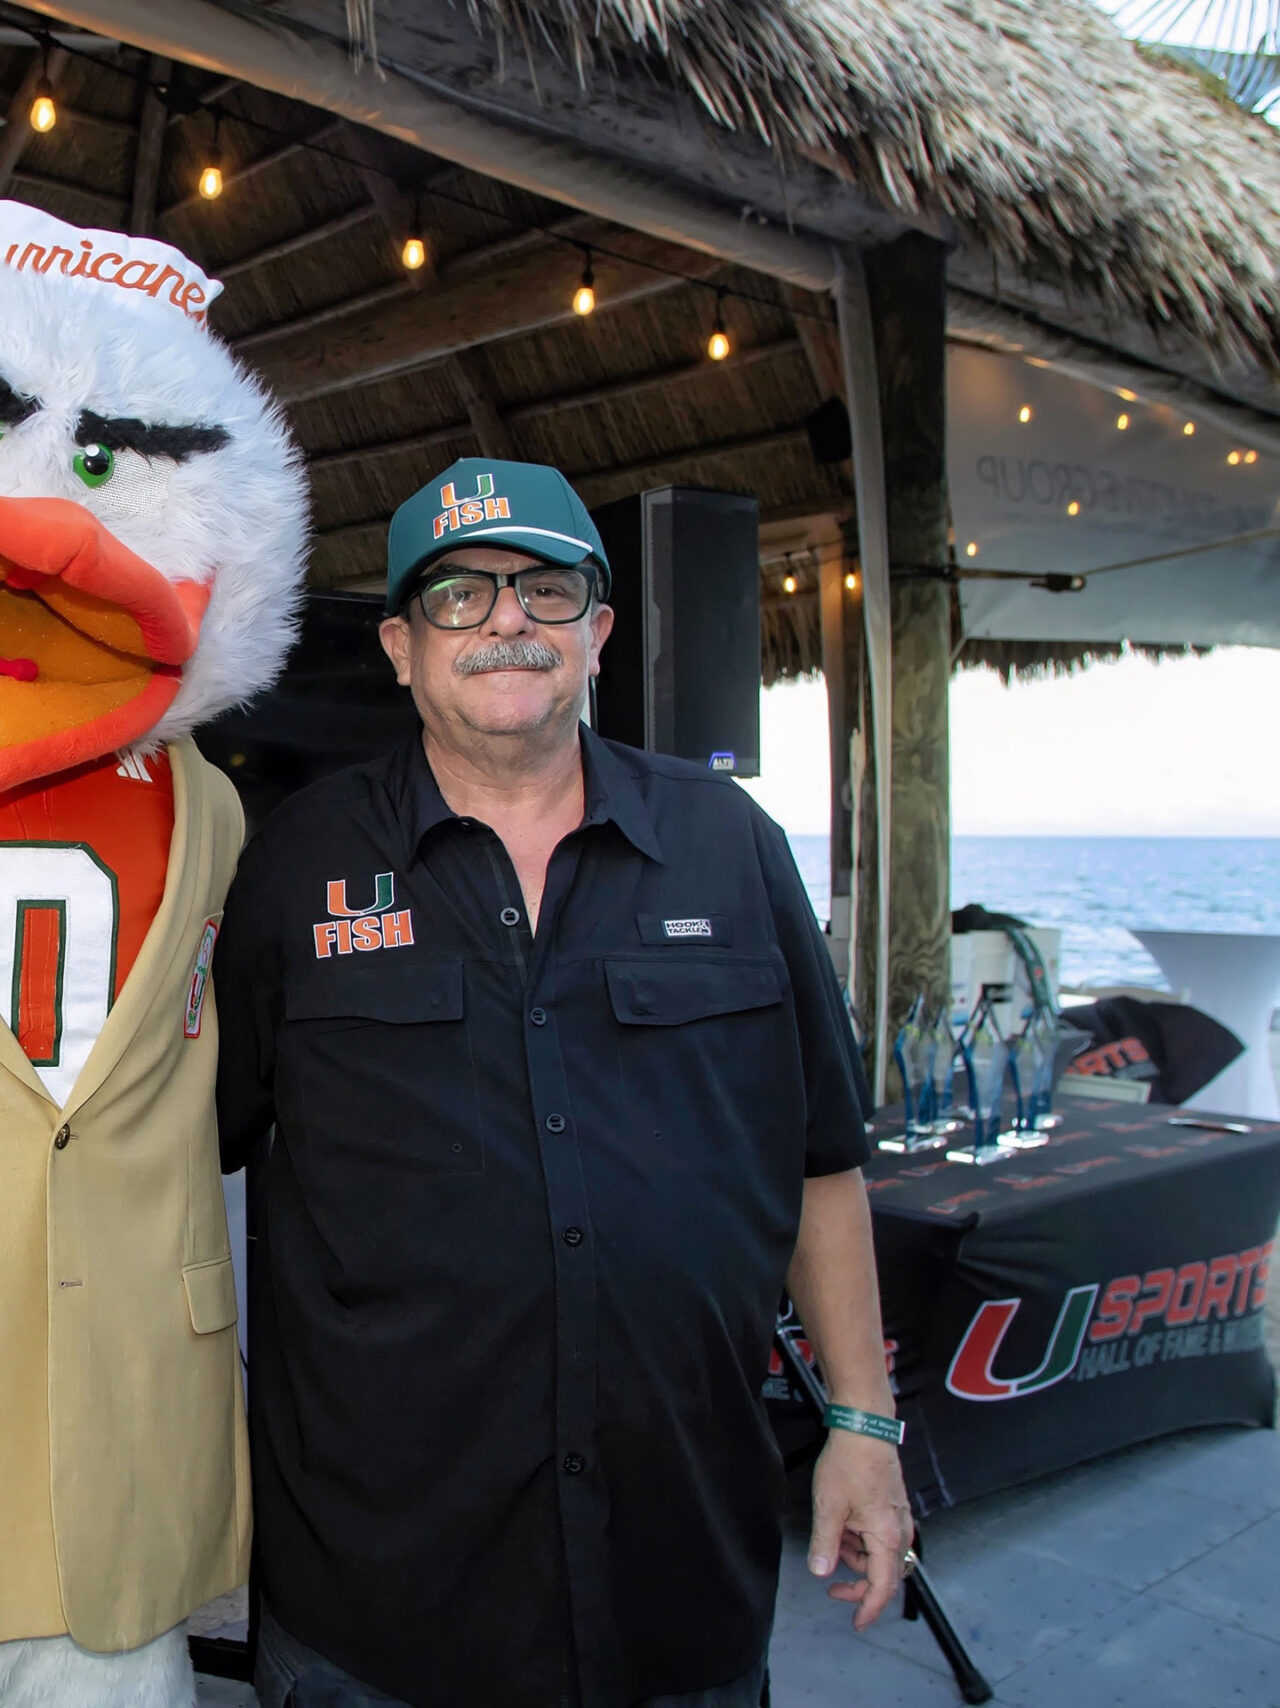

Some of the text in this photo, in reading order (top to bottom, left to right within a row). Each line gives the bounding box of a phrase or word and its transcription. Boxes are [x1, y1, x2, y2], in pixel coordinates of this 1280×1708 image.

[440, 473, 495, 509] U
[432, 497, 511, 540] FISH
[326, 871, 395, 917] U
[313, 908, 415, 959] FISH
[945, 1283, 1100, 1402] U
